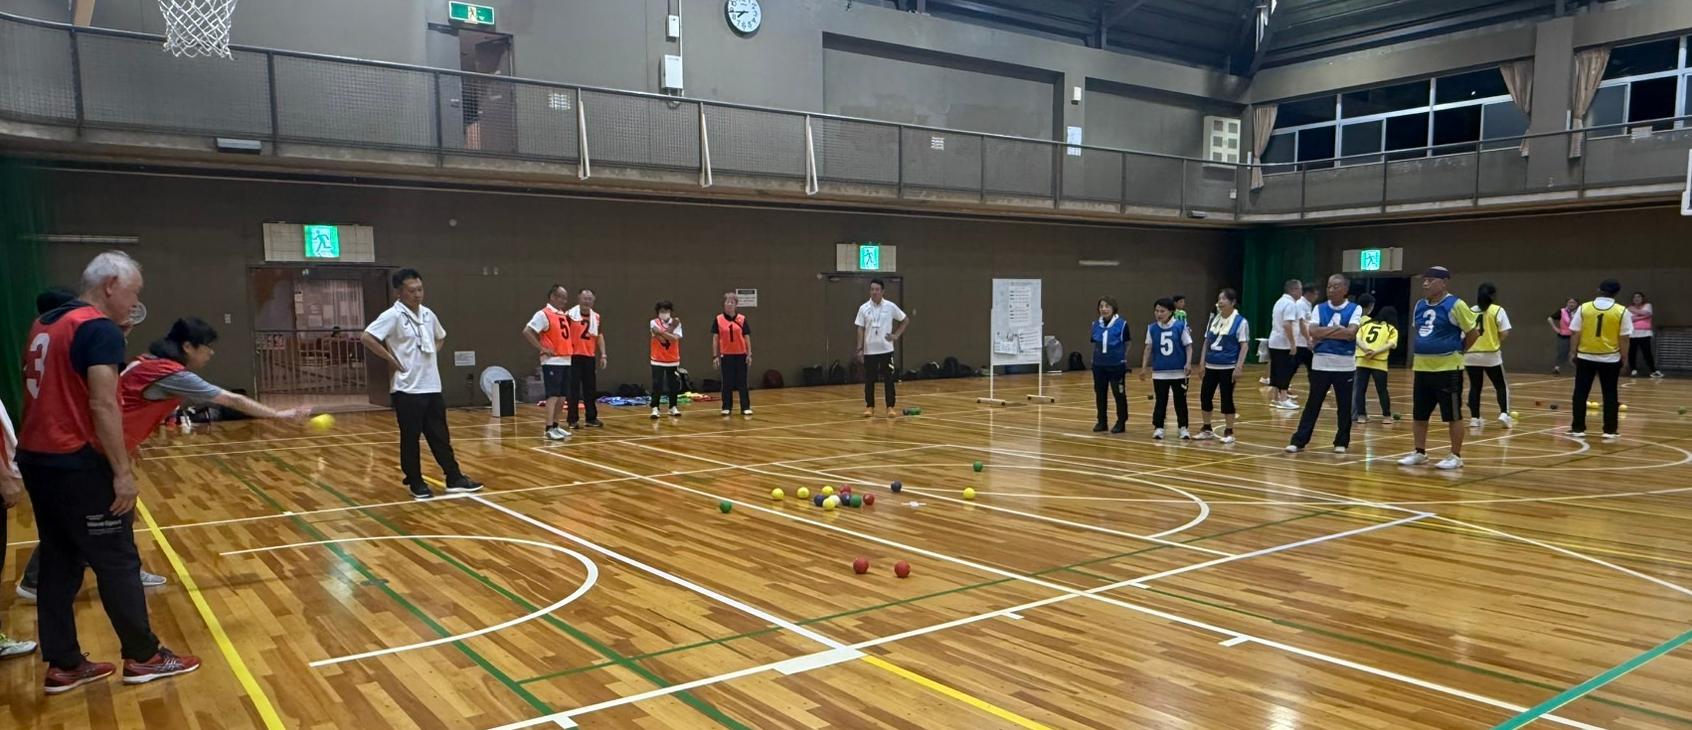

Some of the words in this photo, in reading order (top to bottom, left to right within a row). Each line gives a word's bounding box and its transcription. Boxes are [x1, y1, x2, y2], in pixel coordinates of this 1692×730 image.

[559, 317, 569, 339] 5
[580, 320, 590, 340] 2
[728, 323, 734, 342] 1
[1419, 309, 1436, 337] 3
[1596, 313, 1604, 337] 1
[1102, 330, 1109, 353] 1
[1160, 331, 1174, 356] 5
[1210, 335, 1223, 350] 2
[1366, 326, 1381, 343] 5
[24, 333, 50, 399] 3
